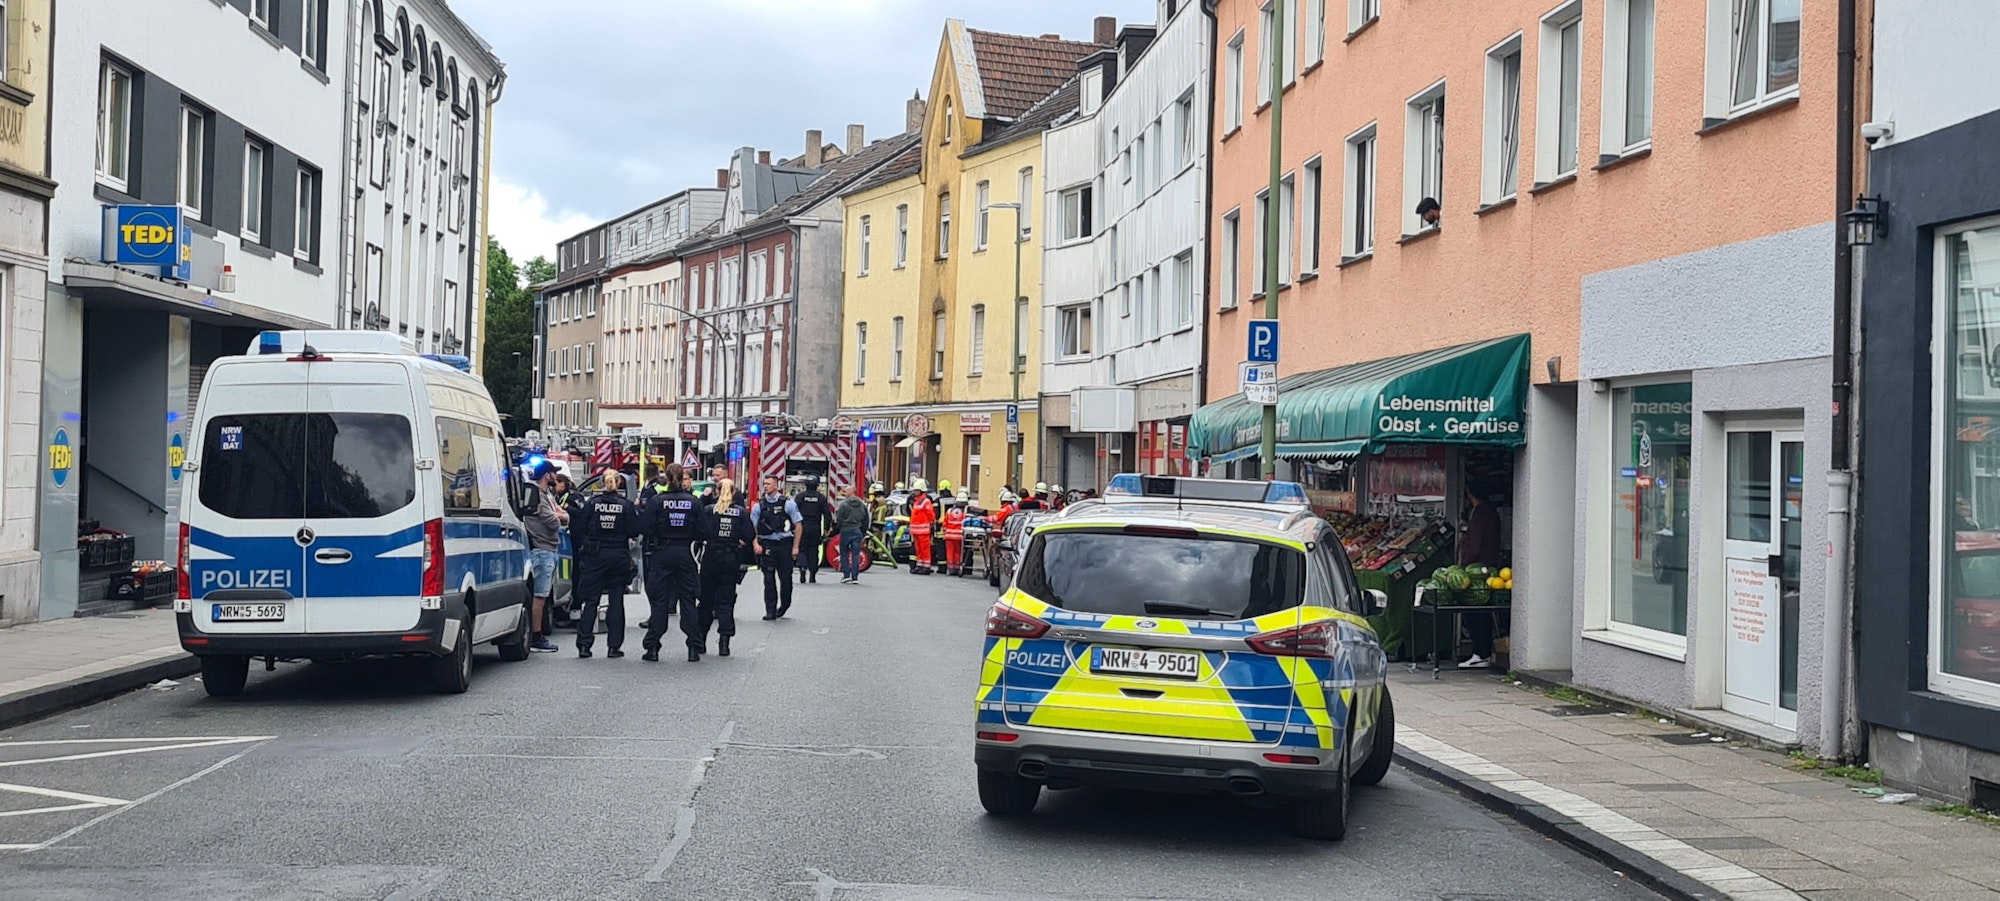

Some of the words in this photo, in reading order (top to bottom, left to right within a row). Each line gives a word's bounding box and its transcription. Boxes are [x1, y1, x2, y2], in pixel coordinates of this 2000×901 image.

[121, 225, 174, 243] TEDi
[1254, 326, 1272, 357] P
[1379, 394, 1494, 412] Lebensmittel
[221, 426, 242, 434] NRW
[1378, 416, 1421, 432] Obst
[1428, 422, 1437, 431] +
[1444, 417, 1519, 434] Gemüse
[223, 442, 240, 450] BAT
[50, 445, 72, 469] TEDi
[594, 503, 623, 513] POLIZEI
[663, 500, 692, 510] POLIZEI
[202, 569, 291, 588] POLIZEI
[220, 606, 240, 617] NRW
[245, 605, 283, 617] 5-5693
[1007, 651, 1066, 668] POLIZEI
[1101, 650, 1130, 668] NRW
[1139, 653, 1197, 673] 4-9501
